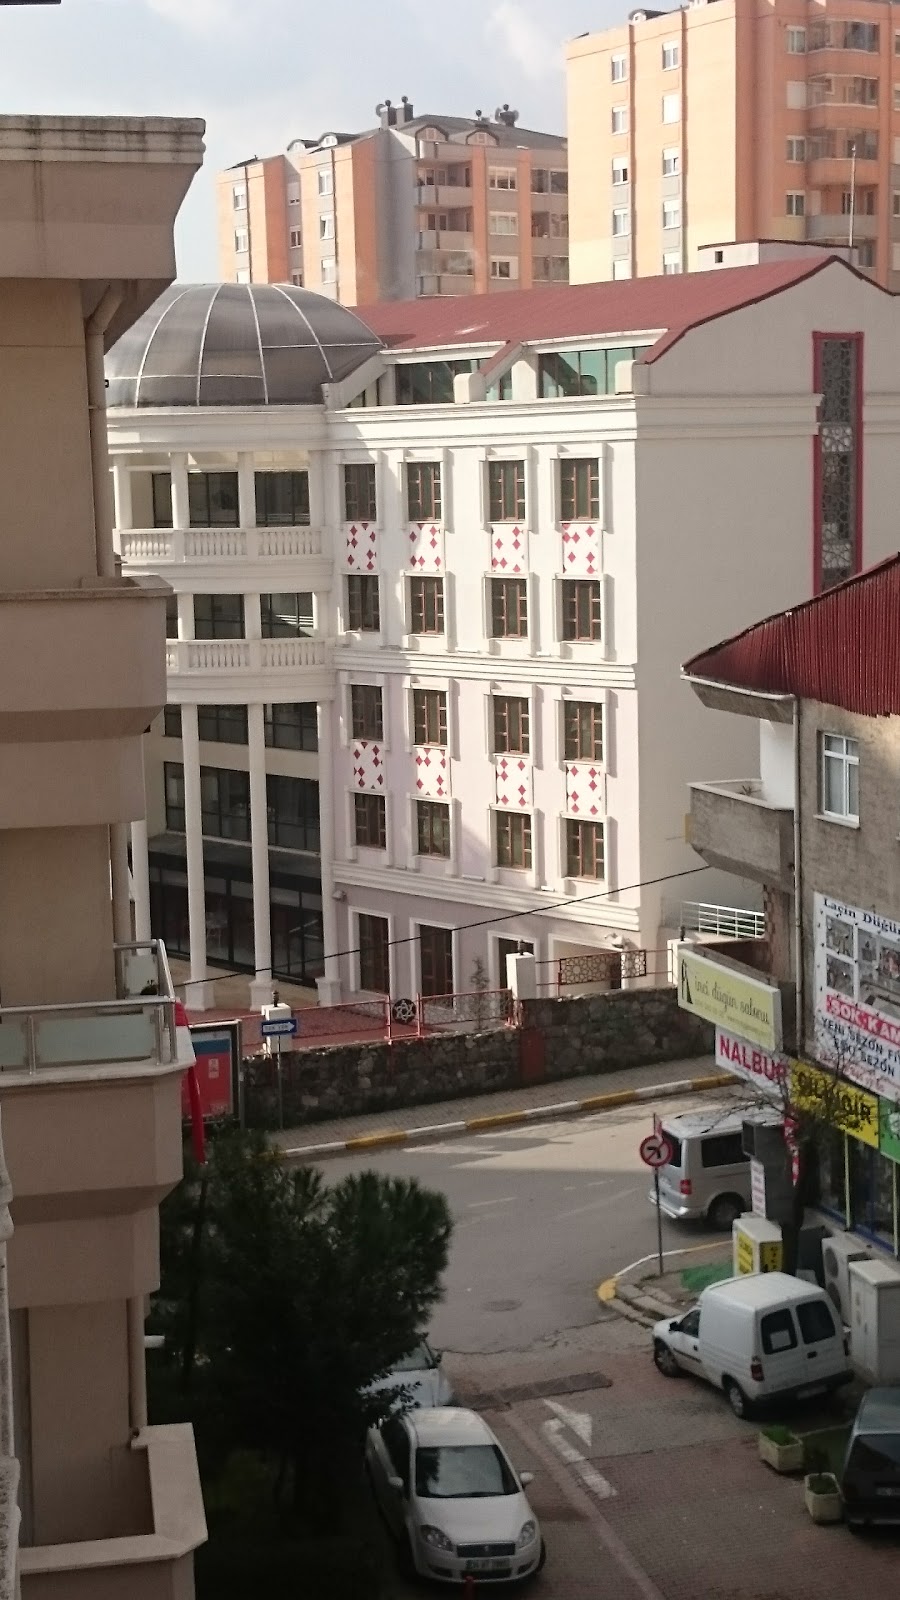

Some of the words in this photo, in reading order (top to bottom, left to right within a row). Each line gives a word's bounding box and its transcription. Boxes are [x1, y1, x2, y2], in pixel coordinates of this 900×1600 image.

[863, 913, 900, 935] Düğü
[740, 998, 770, 1024] salonu
[720, 1035, 787, 1086] NALBUR
